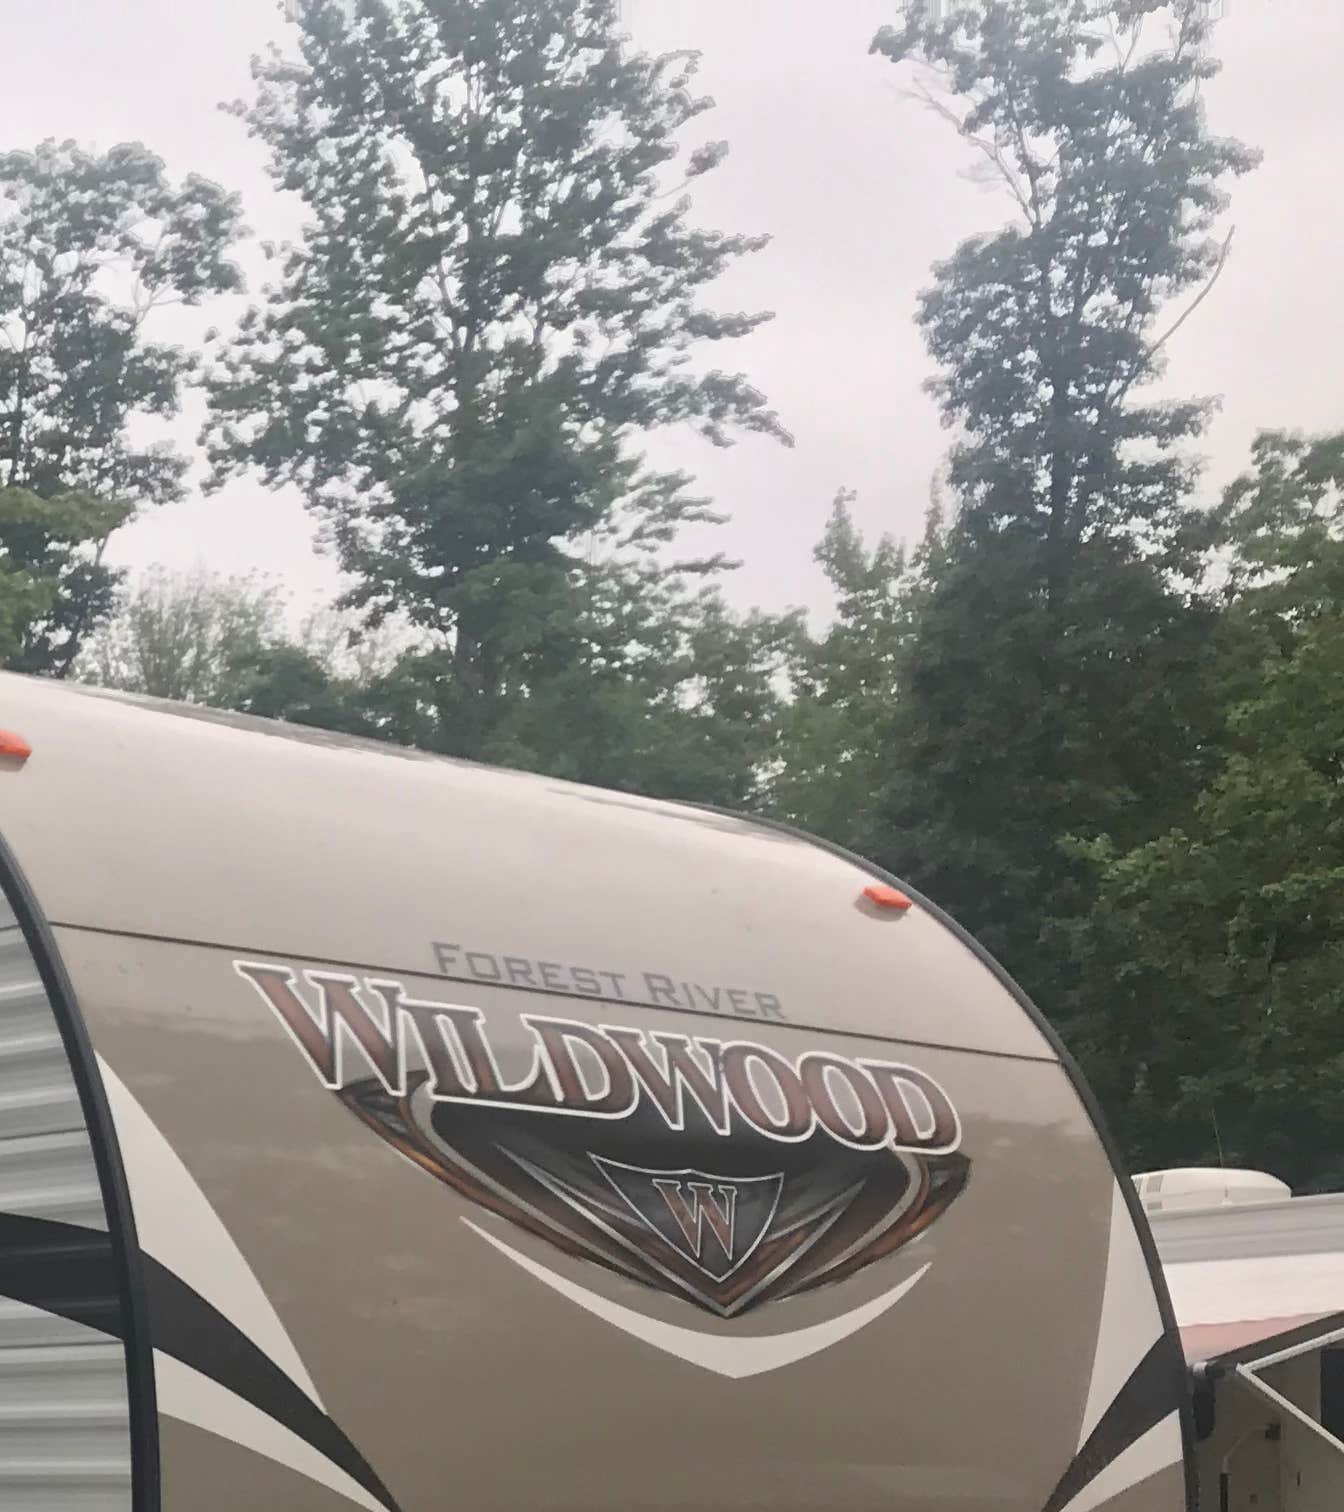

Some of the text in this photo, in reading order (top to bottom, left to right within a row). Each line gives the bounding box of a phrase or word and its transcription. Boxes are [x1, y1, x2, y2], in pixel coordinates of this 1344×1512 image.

[431, 941, 787, 1020] FOREST RIVER
[231, 959, 963, 1155] WILDWOOD
[651, 1179, 739, 1261] W
